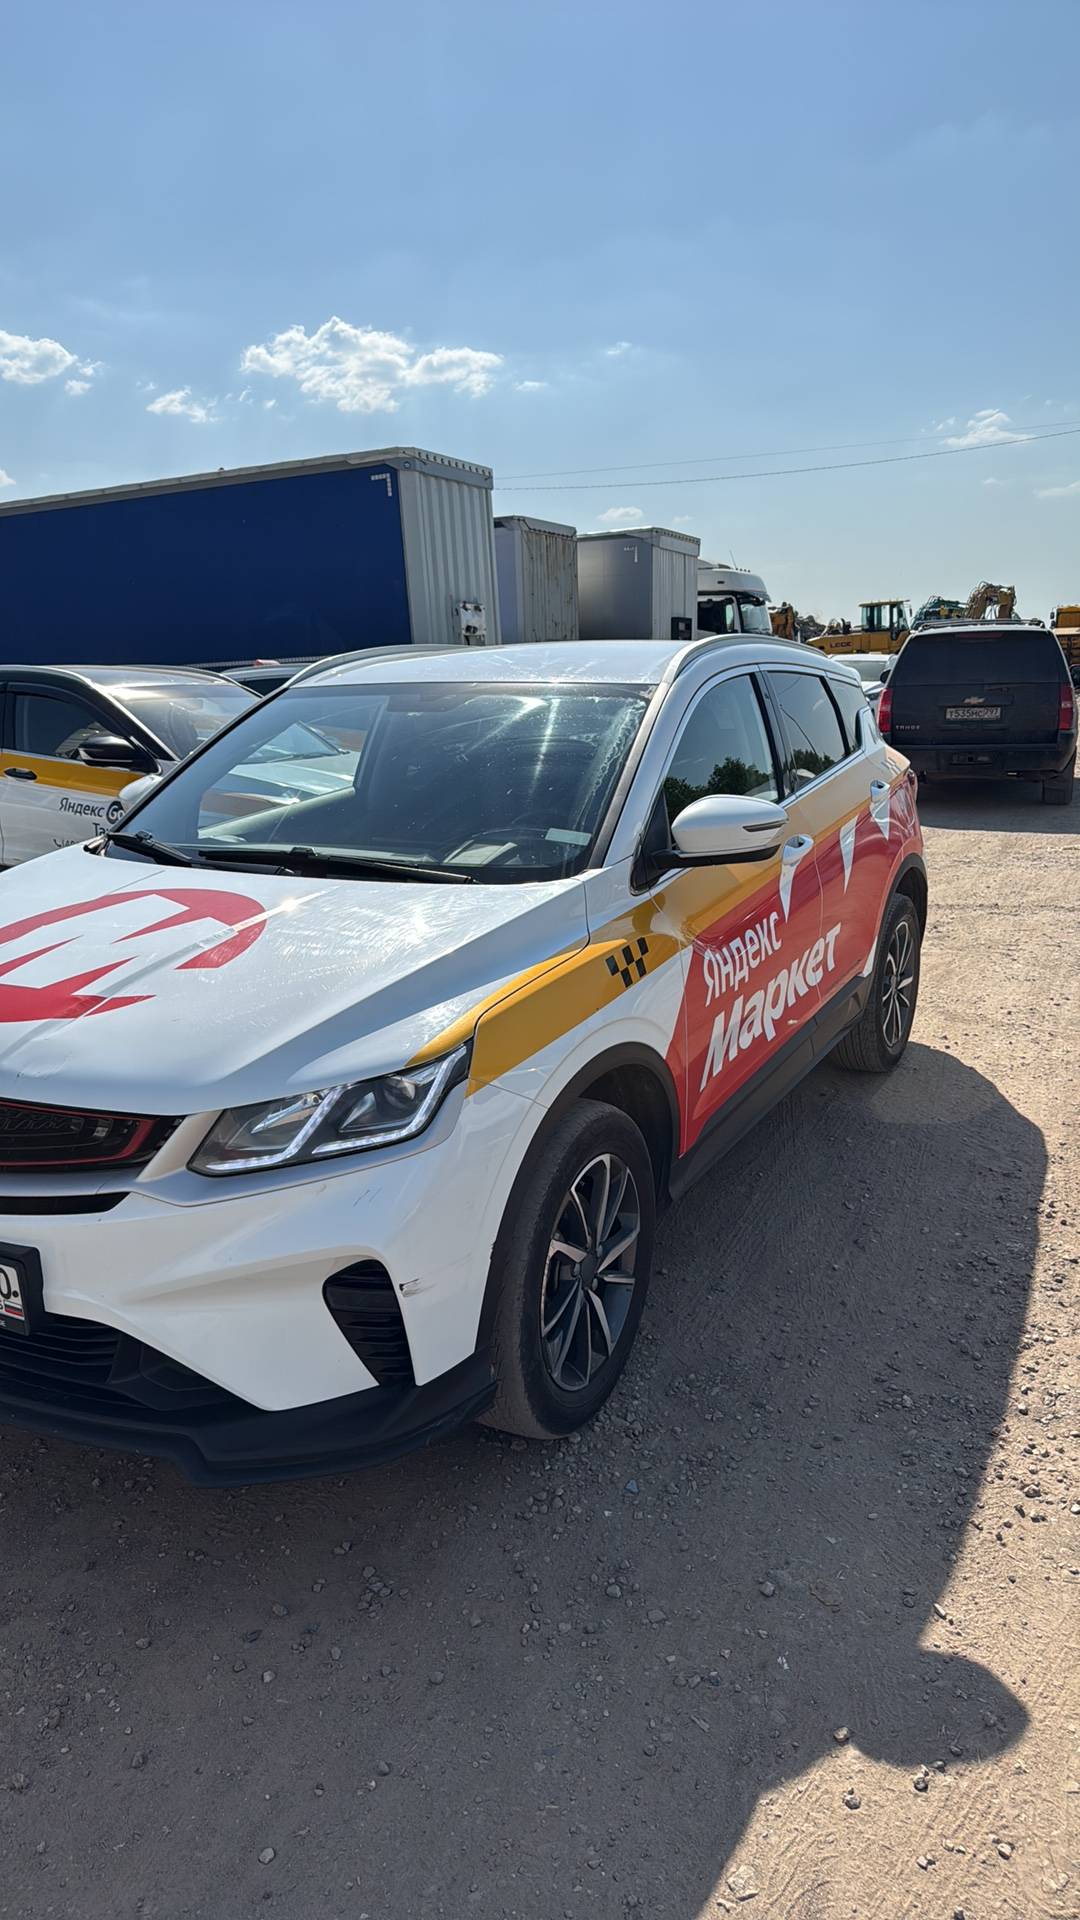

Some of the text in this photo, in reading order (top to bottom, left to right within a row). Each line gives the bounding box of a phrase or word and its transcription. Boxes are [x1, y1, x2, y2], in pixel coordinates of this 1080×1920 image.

[59, 797, 105, 818] Яндекс
[700, 922, 842, 1093] Маркет
[703, 911, 783, 1008] Яндекс
